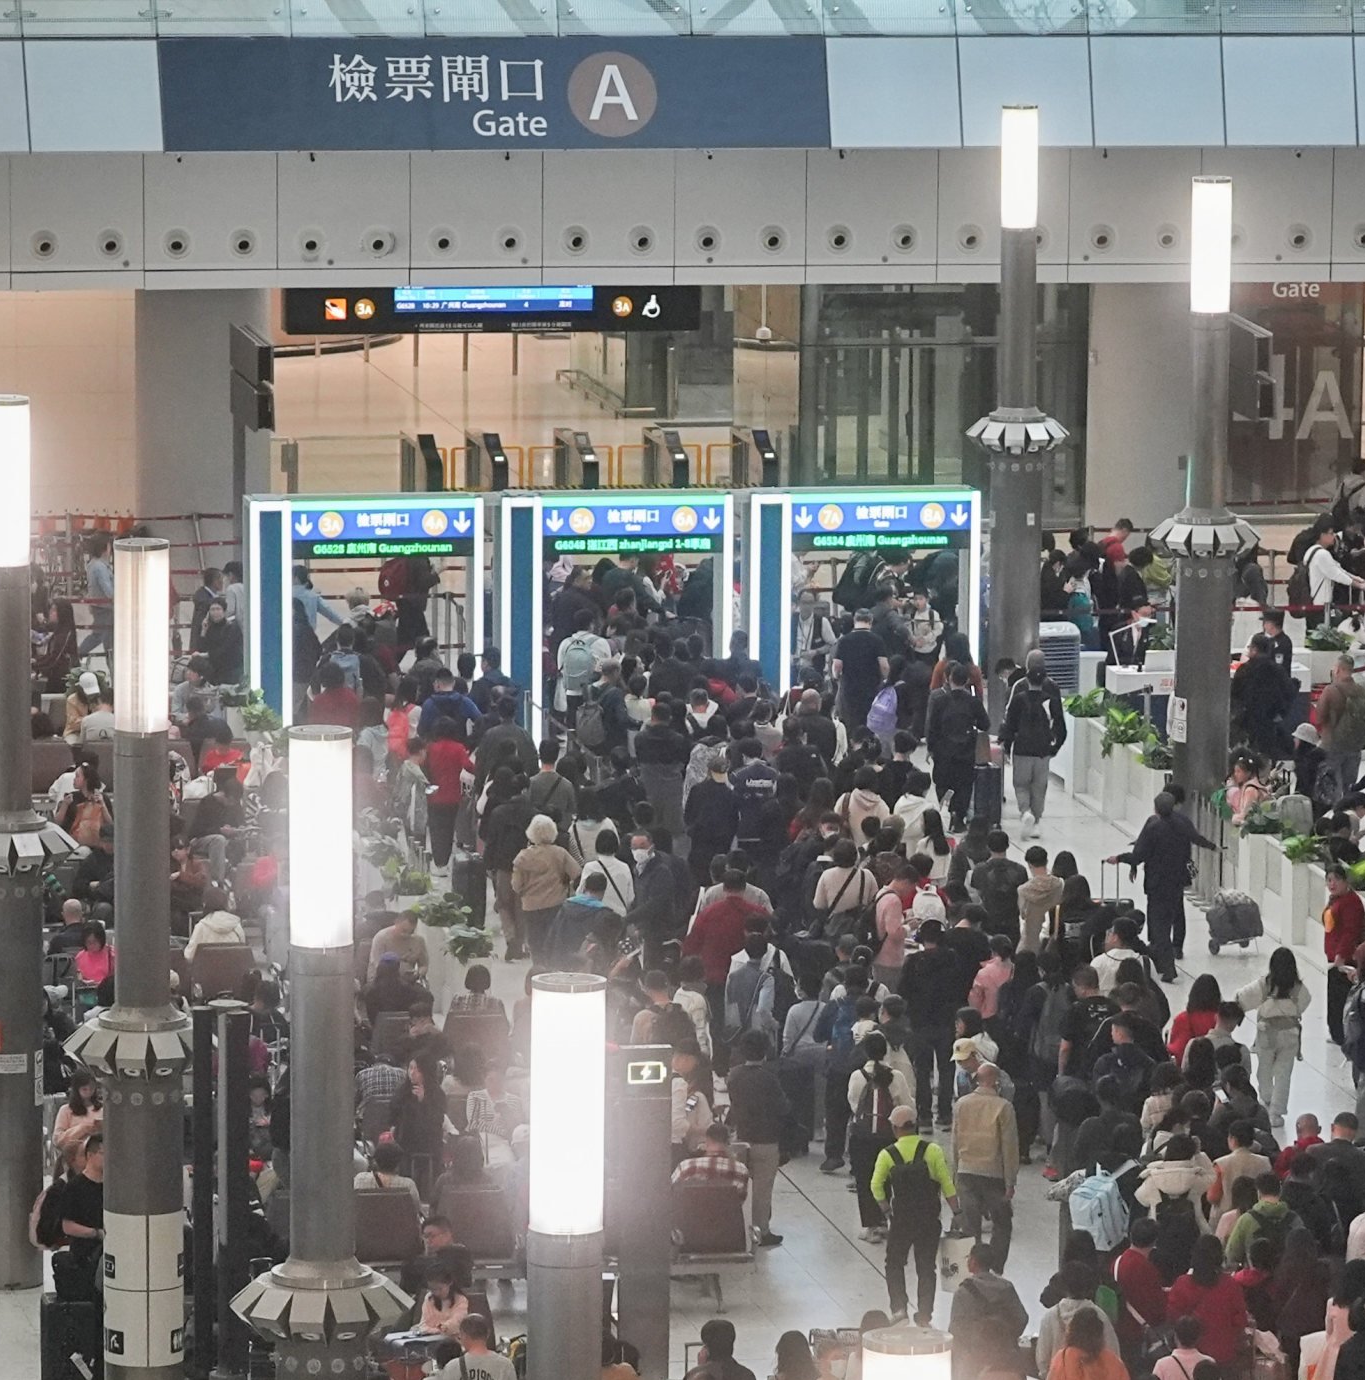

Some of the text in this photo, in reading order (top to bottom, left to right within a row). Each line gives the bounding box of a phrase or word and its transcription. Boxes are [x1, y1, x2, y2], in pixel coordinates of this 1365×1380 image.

[328, 54, 544, 103] 檢票閘口
[589, 65, 638, 121] A
[472, 110, 548, 138] Gate
[1272, 281, 1321, 298] Gate
[357, 303, 372, 315] 3A
[615, 300, 630, 312] 3A
